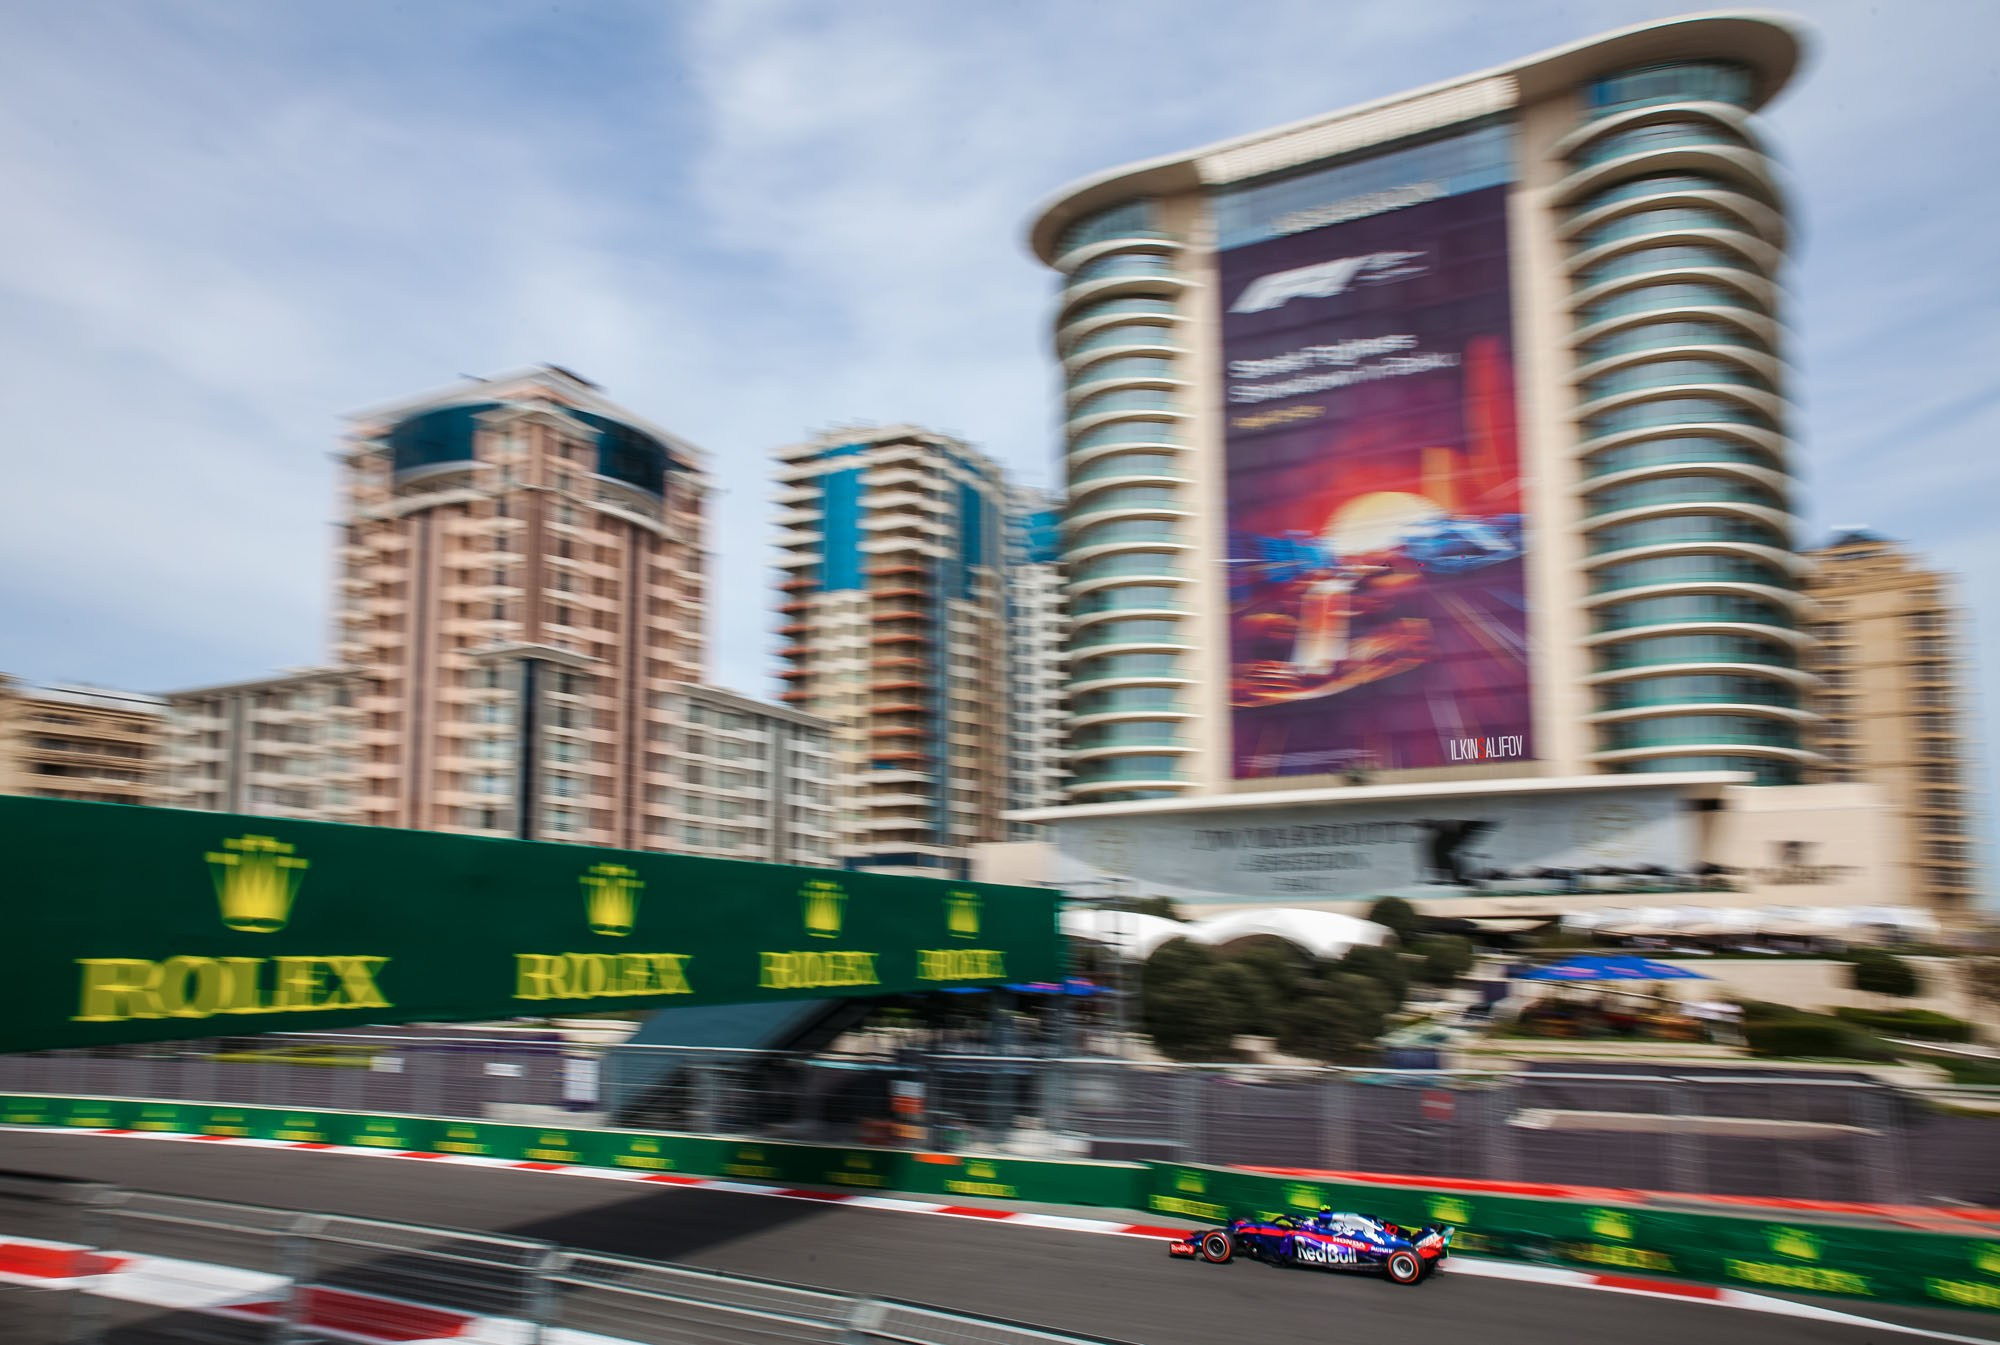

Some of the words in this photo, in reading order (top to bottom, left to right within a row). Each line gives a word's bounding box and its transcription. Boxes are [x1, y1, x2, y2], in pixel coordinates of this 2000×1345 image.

[70, 954, 393, 1022] ROLEX
[513, 952, 694, 1000] ROLEX
[1333, 1236, 1366, 1249] HONDA
